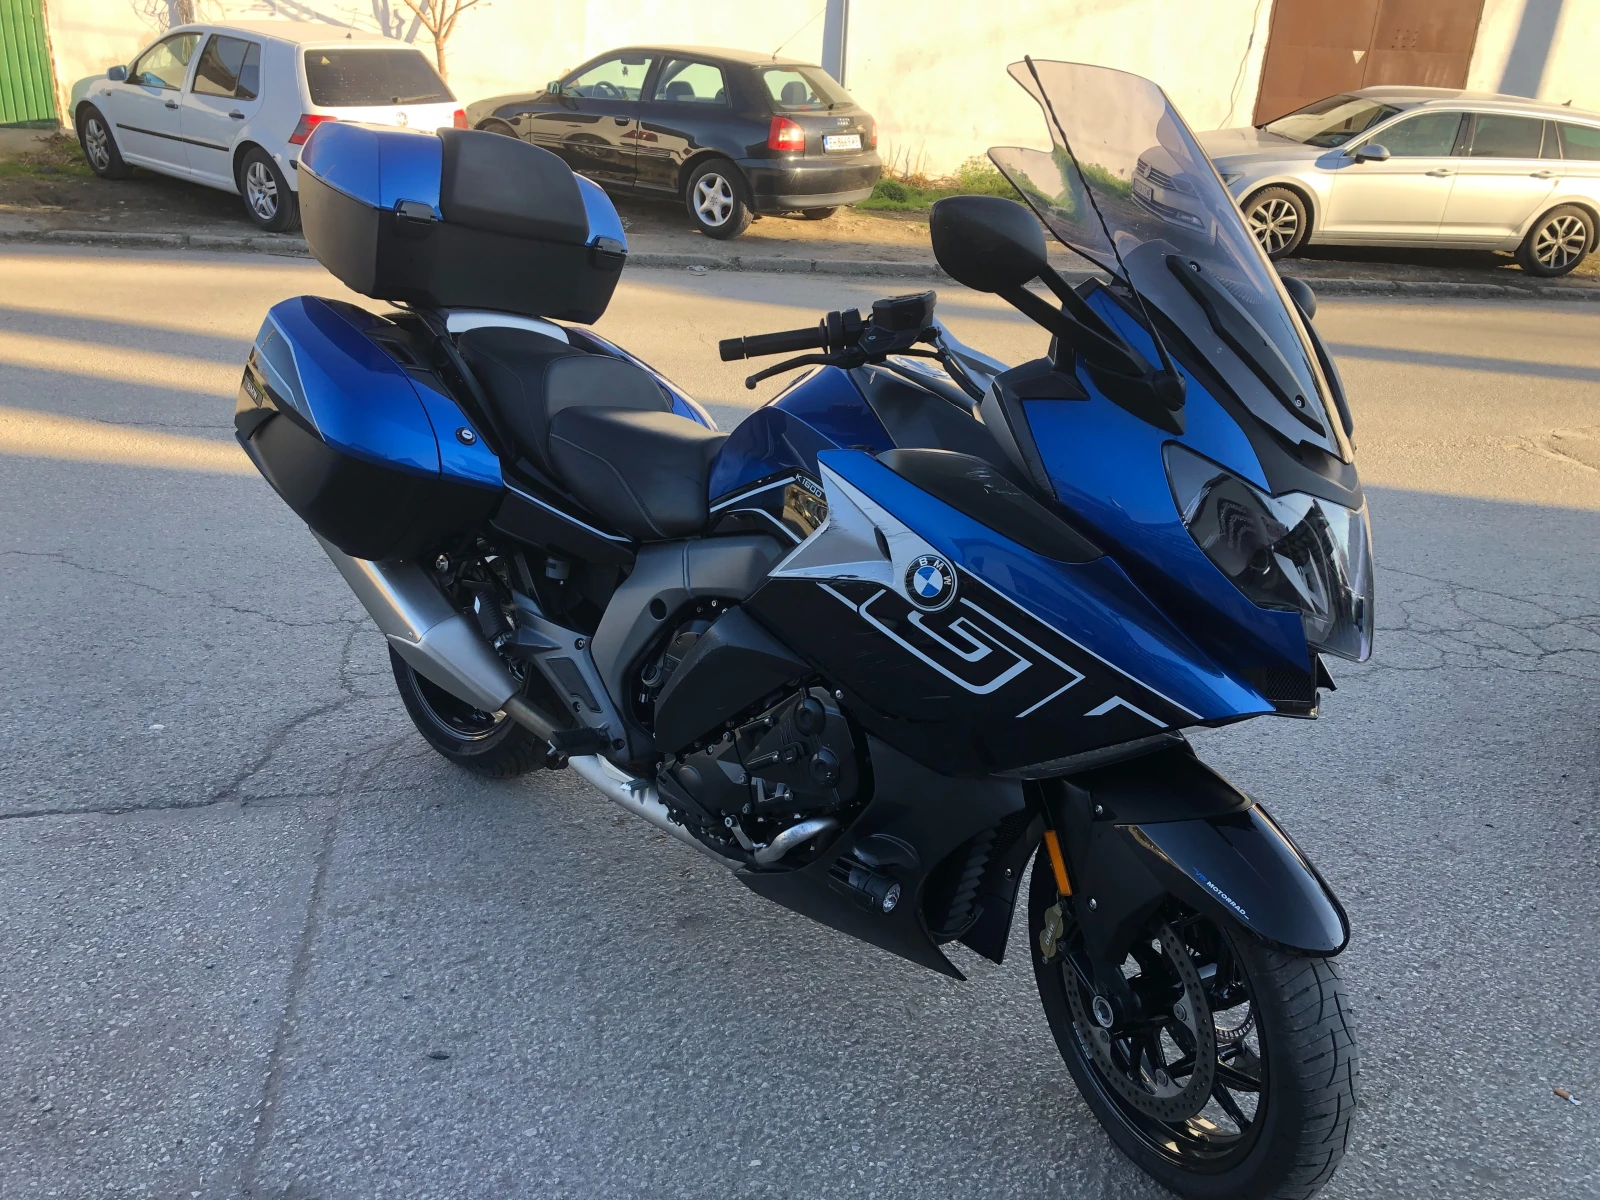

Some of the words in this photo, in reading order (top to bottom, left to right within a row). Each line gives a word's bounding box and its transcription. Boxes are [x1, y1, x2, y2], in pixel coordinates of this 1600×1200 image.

[795, 473, 803, 483] K
[801, 478, 823, 498] 1600
[918, 556, 953, 586] BMW
[1206, 881, 1247, 916] MOTORRAD
